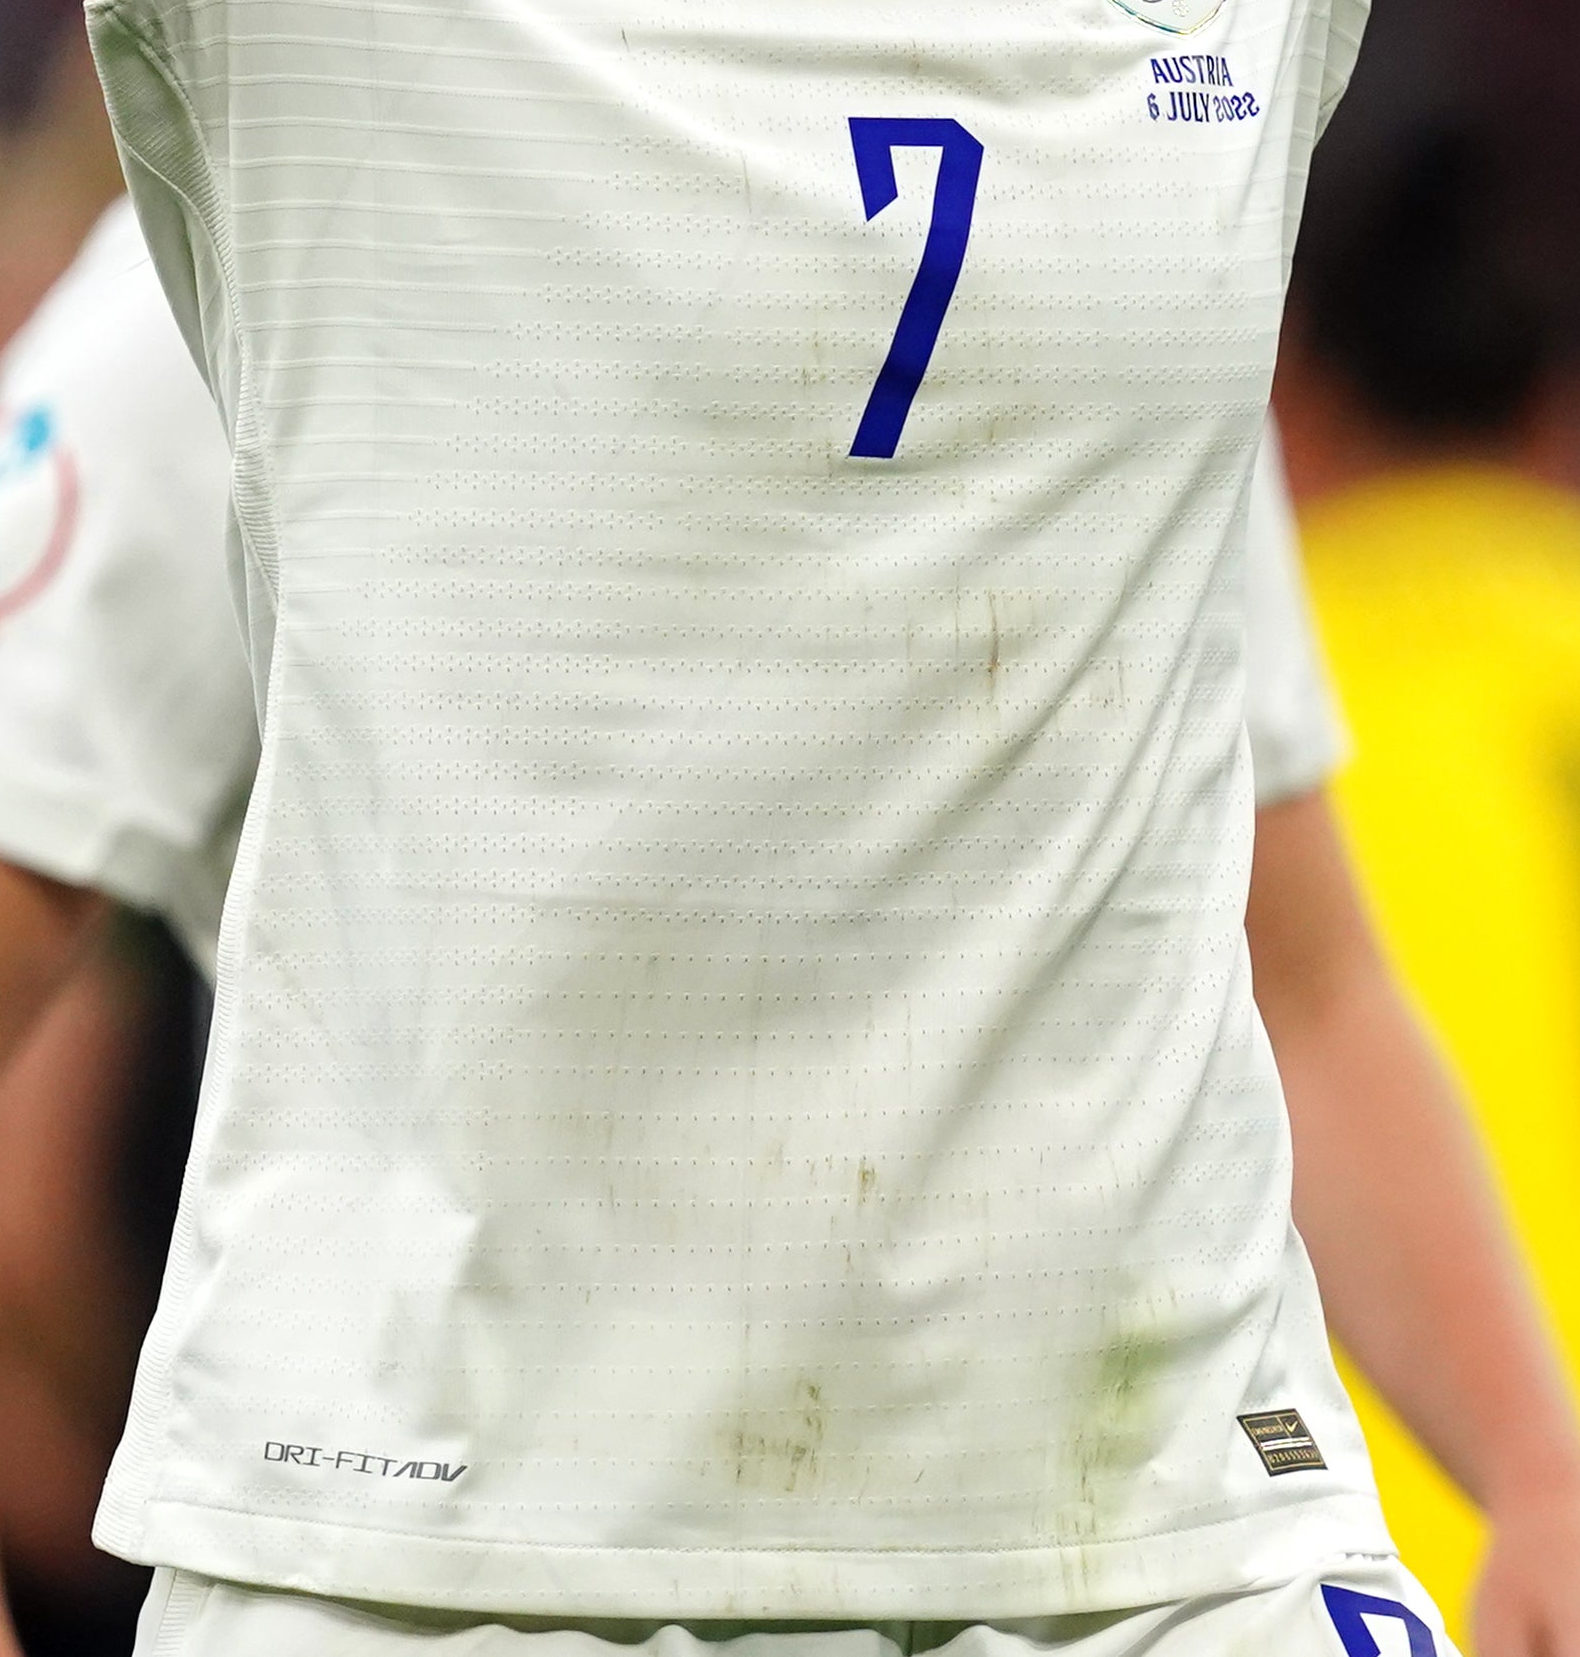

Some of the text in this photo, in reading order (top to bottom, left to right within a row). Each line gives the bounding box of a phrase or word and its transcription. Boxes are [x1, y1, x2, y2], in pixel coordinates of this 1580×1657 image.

[1150, 54, 1234, 87] AUSTRIA
[1146, 91, 1261, 123] 6 JULY 2022
[847, 116, 985, 459] 7
